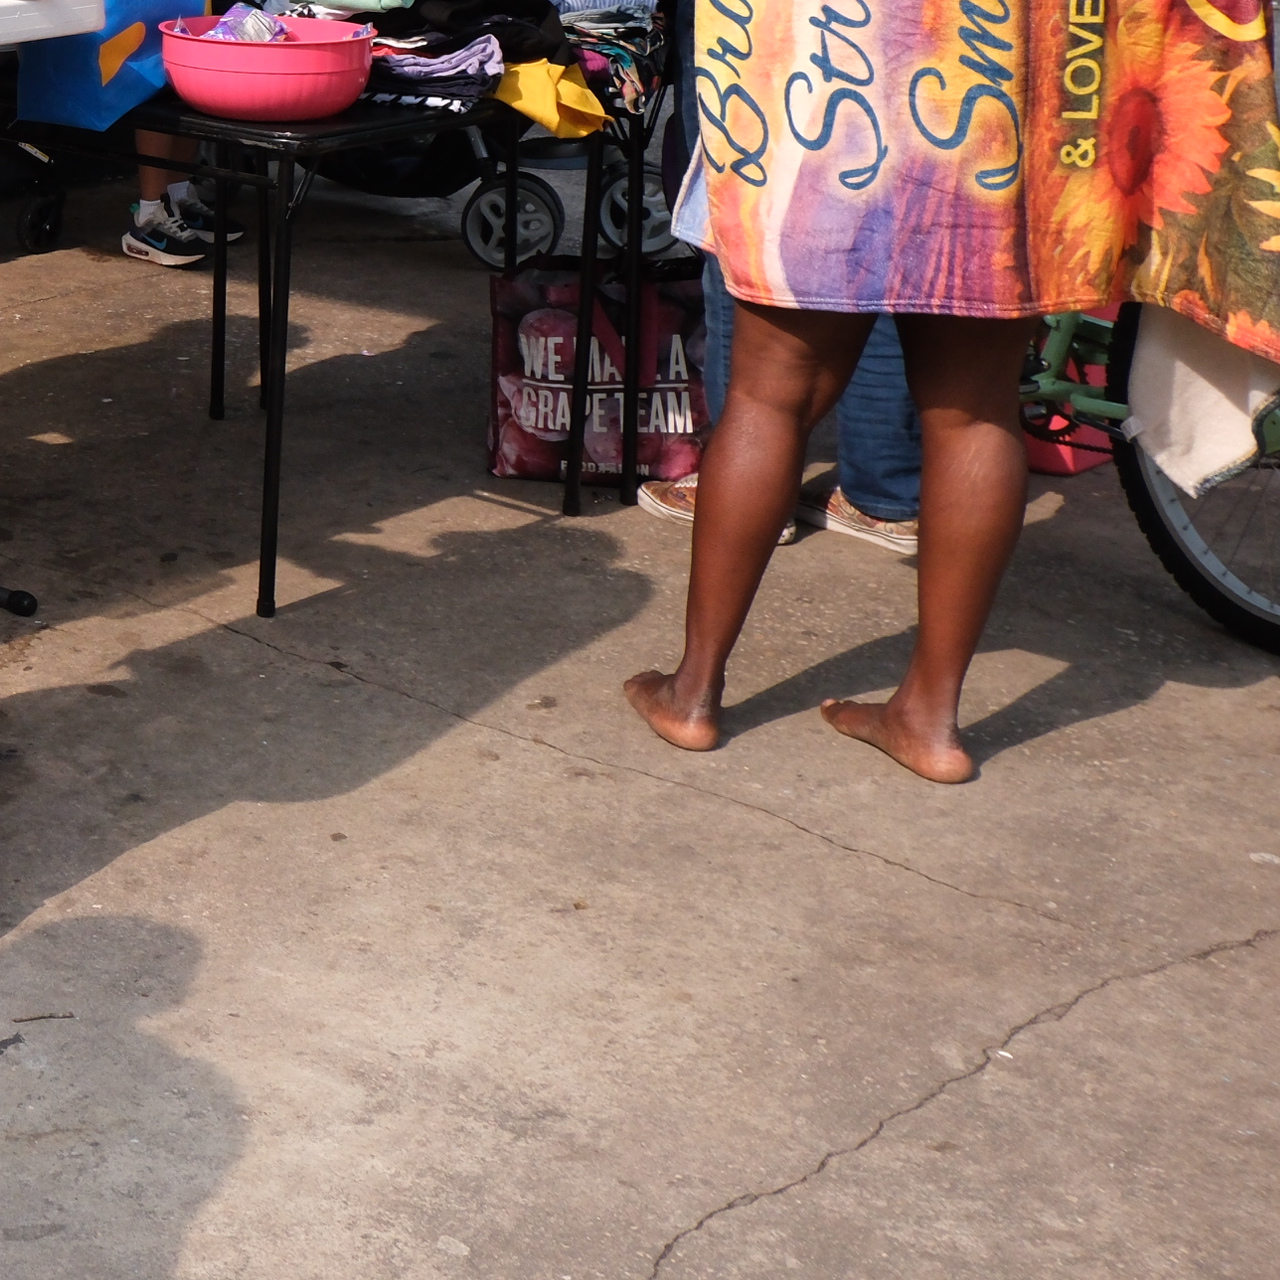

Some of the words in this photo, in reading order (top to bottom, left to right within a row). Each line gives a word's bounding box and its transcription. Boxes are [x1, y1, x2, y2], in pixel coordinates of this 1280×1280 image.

[1060, 133, 1096, 170] &
[519, 334, 564, 381] WE
[669, 334, 689, 381] A
